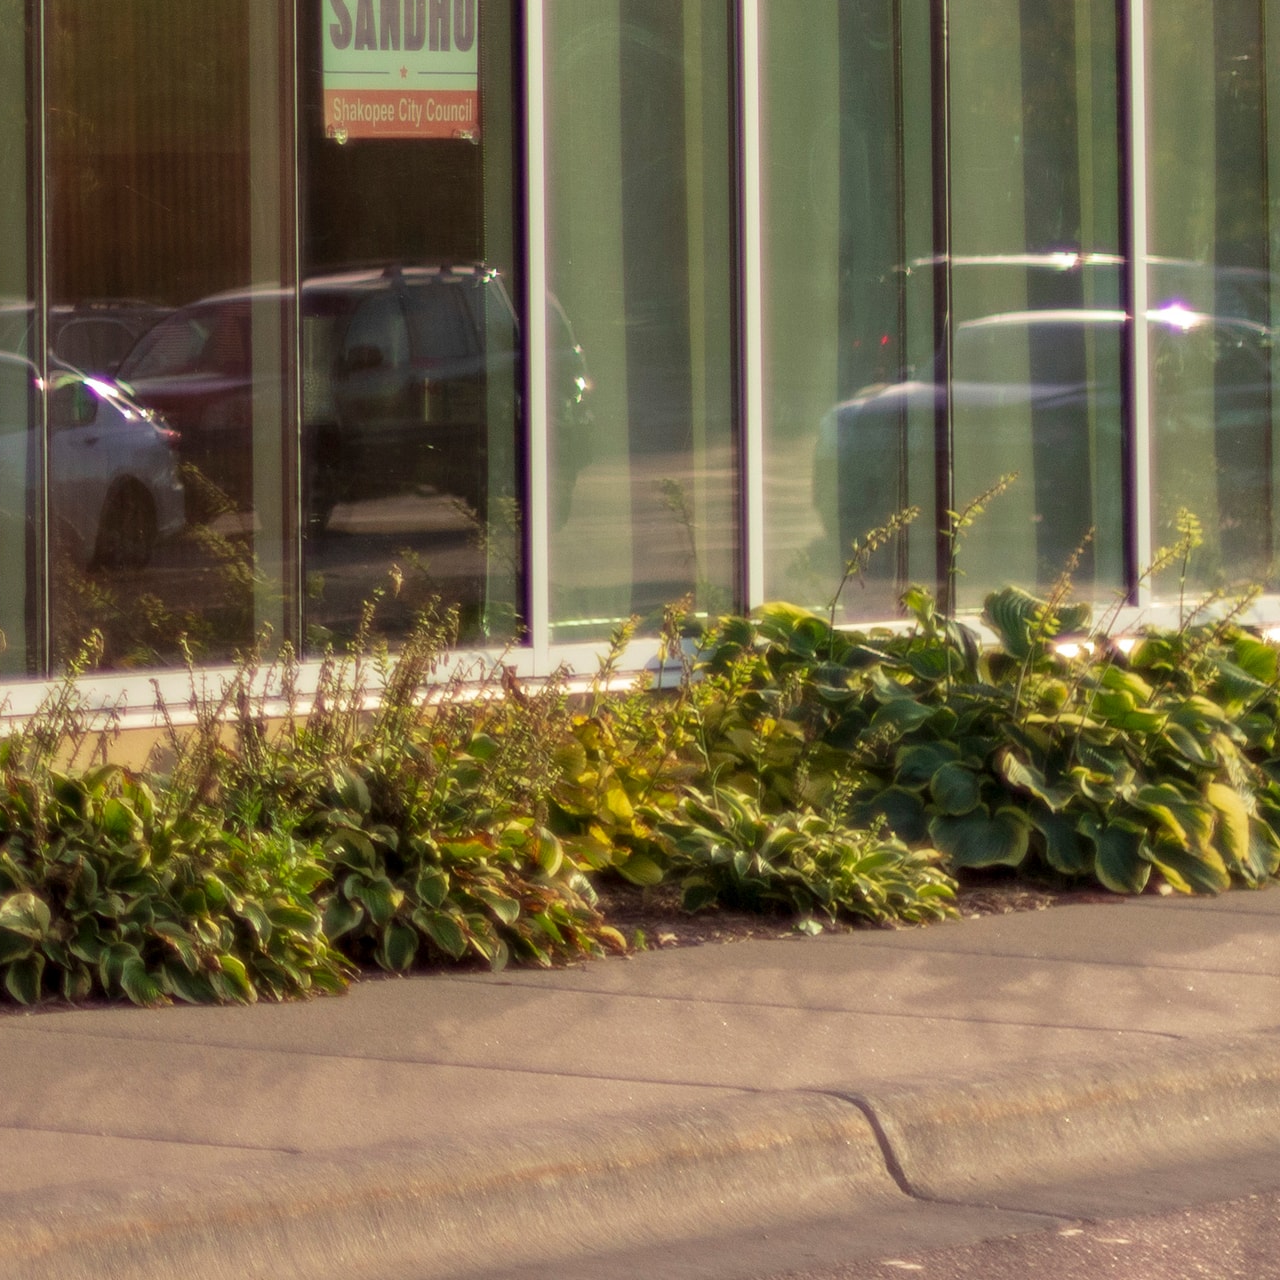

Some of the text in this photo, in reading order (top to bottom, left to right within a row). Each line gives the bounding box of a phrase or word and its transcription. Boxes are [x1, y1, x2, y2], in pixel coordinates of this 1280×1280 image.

[333, 96, 473, 128] Shakopee City Council
